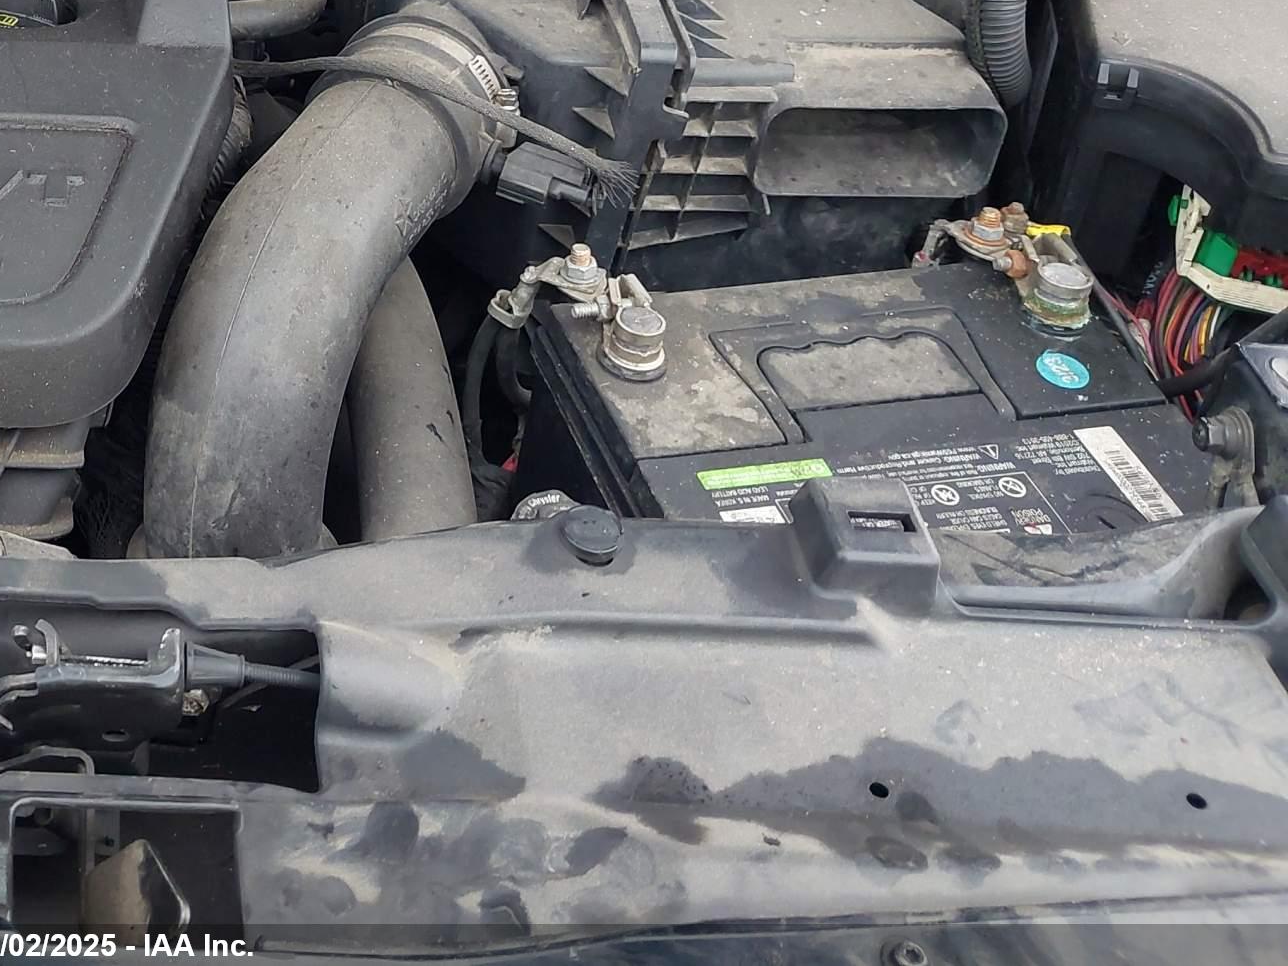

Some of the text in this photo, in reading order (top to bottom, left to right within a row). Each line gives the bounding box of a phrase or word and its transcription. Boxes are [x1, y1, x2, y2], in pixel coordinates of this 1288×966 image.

[902, 459, 917, 467] and
[916, 456, 943, 465] Cancer
[837, 465, 858, 475] Harm
[857, 461, 903, 473] Reproductive
[711, 490, 738, 498] BATTERY
[737, 487, 752, 495] ACID
[751, 485, 769, 494] LEAD
[527, 493, 561, 508] Chrysler
